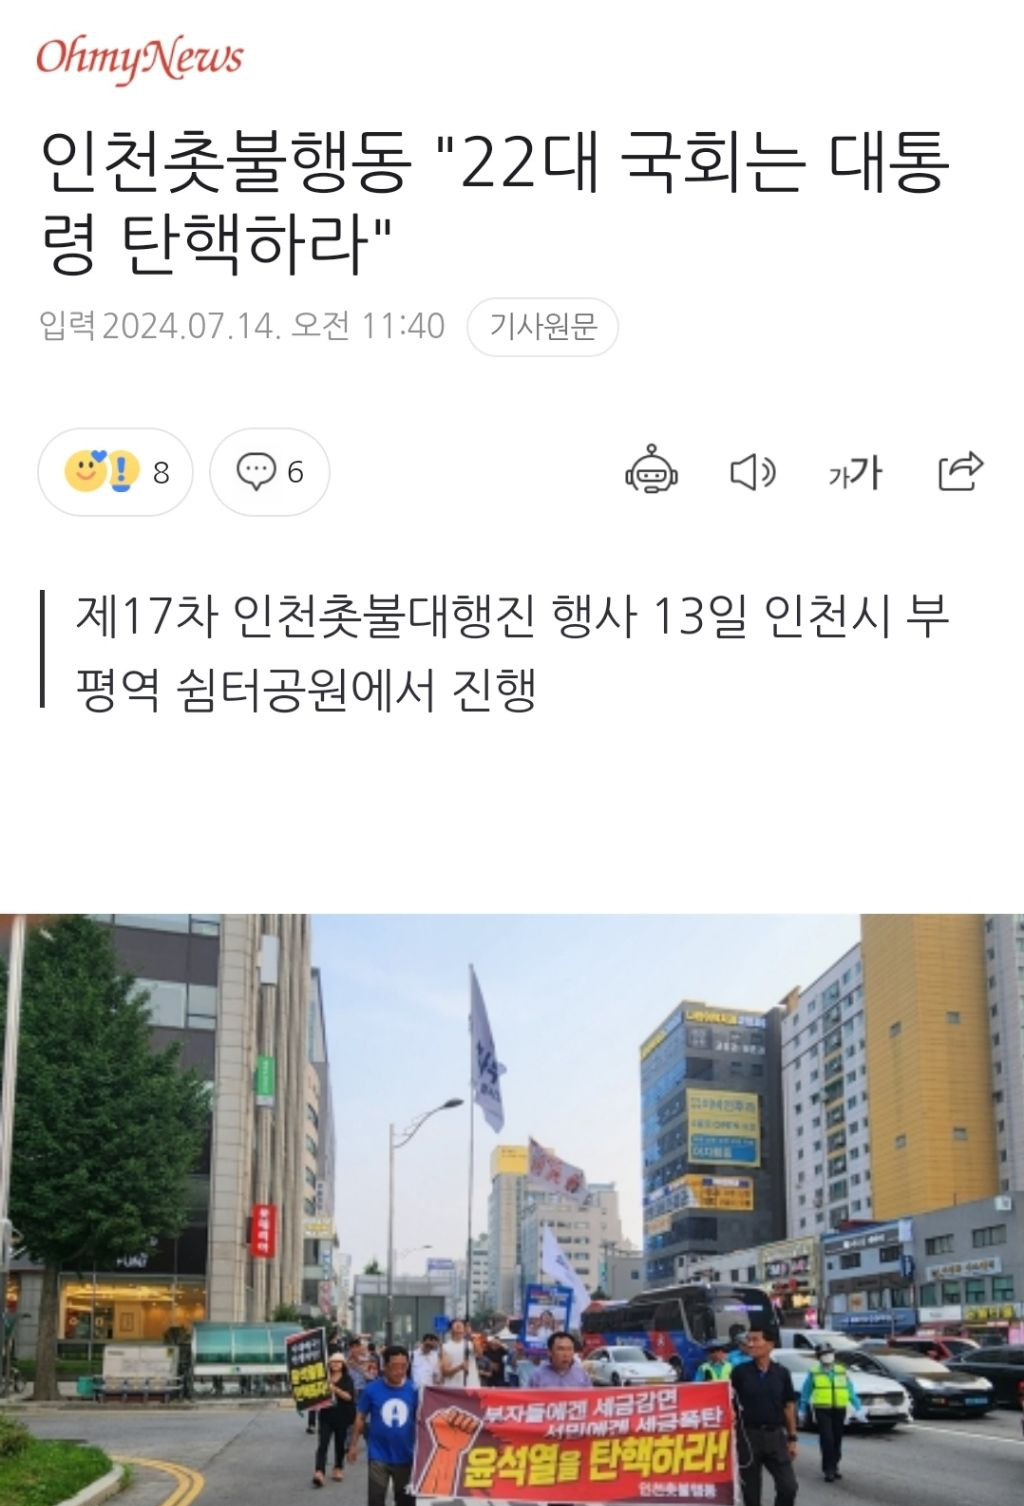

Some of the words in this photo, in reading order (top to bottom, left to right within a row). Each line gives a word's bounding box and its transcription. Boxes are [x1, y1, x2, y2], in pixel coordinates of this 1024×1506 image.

[37, 34, 244, 88] OhmyNews
[43, 130, 412, 194] 인천촛불행동
[438, 130, 596, 193] "22대
[621, 130, 806, 194] 국회는
[831, 130, 949, 194] 대통
[45, 213, 93, 276] 령
[124, 213, 390, 276] 탄핵하라"
[39, 311, 96, 341] 입력
[102, 311, 282, 340] 2024.07.14.
[291, 310, 350, 341] 오전
[362, 312, 445, 339] 11:40
[492, 312, 598, 340] 기사원문
[154, 461, 169, 484] 8
[288, 460, 303, 483] 6
[76, 594, 219, 639] 제17차
[235, 594, 533, 639] 인천촛불대행진
[552, 594, 638, 639] 행사
[656, 594, 745, 639] 13일
[766, 594, 888, 639] 인천시
[907, 594, 949, 638] 부
[77, 668, 157, 713] 평역
[177, 668, 432, 713] 쉼터공원에서
[454, 668, 534, 713] 진행
[483, 1399, 588, 1424] 부자들에겐
[592, 1387, 677, 1417] 세금감면
[635, 1405, 723, 1432] 세금폭탄
[463, 1443, 582, 1488] 윤석열을
[589, 1430, 729, 1481] 탄핵하라!
[638, 1481, 718, 1498] 인천촛불행동
